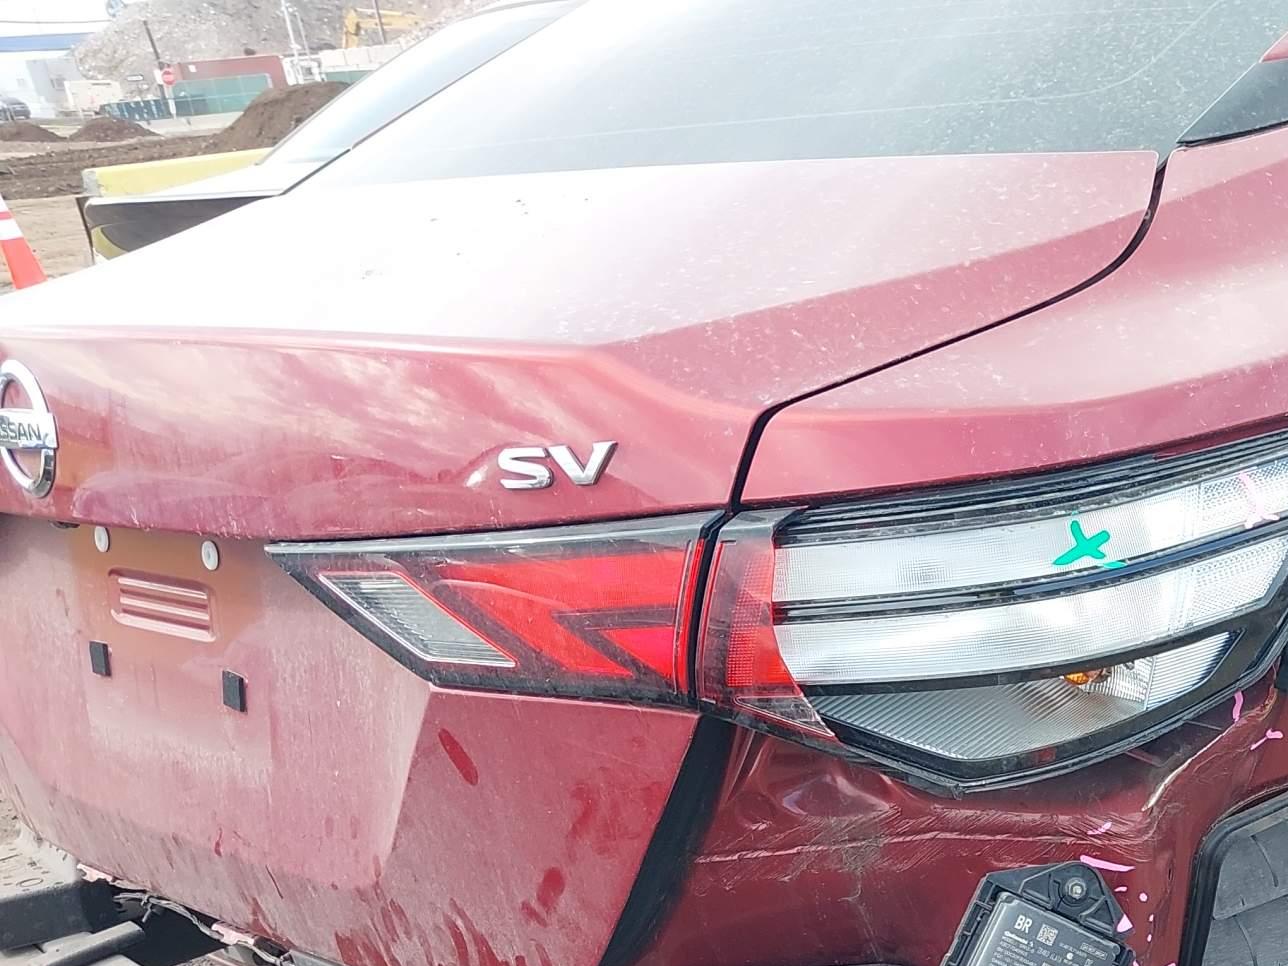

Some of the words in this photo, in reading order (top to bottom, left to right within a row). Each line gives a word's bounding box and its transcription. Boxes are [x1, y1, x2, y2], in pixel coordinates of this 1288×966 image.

[0, 422, 42, 441] SSAN
[498, 440, 618, 490] SV
[1014, 915, 1033, 934] BR
